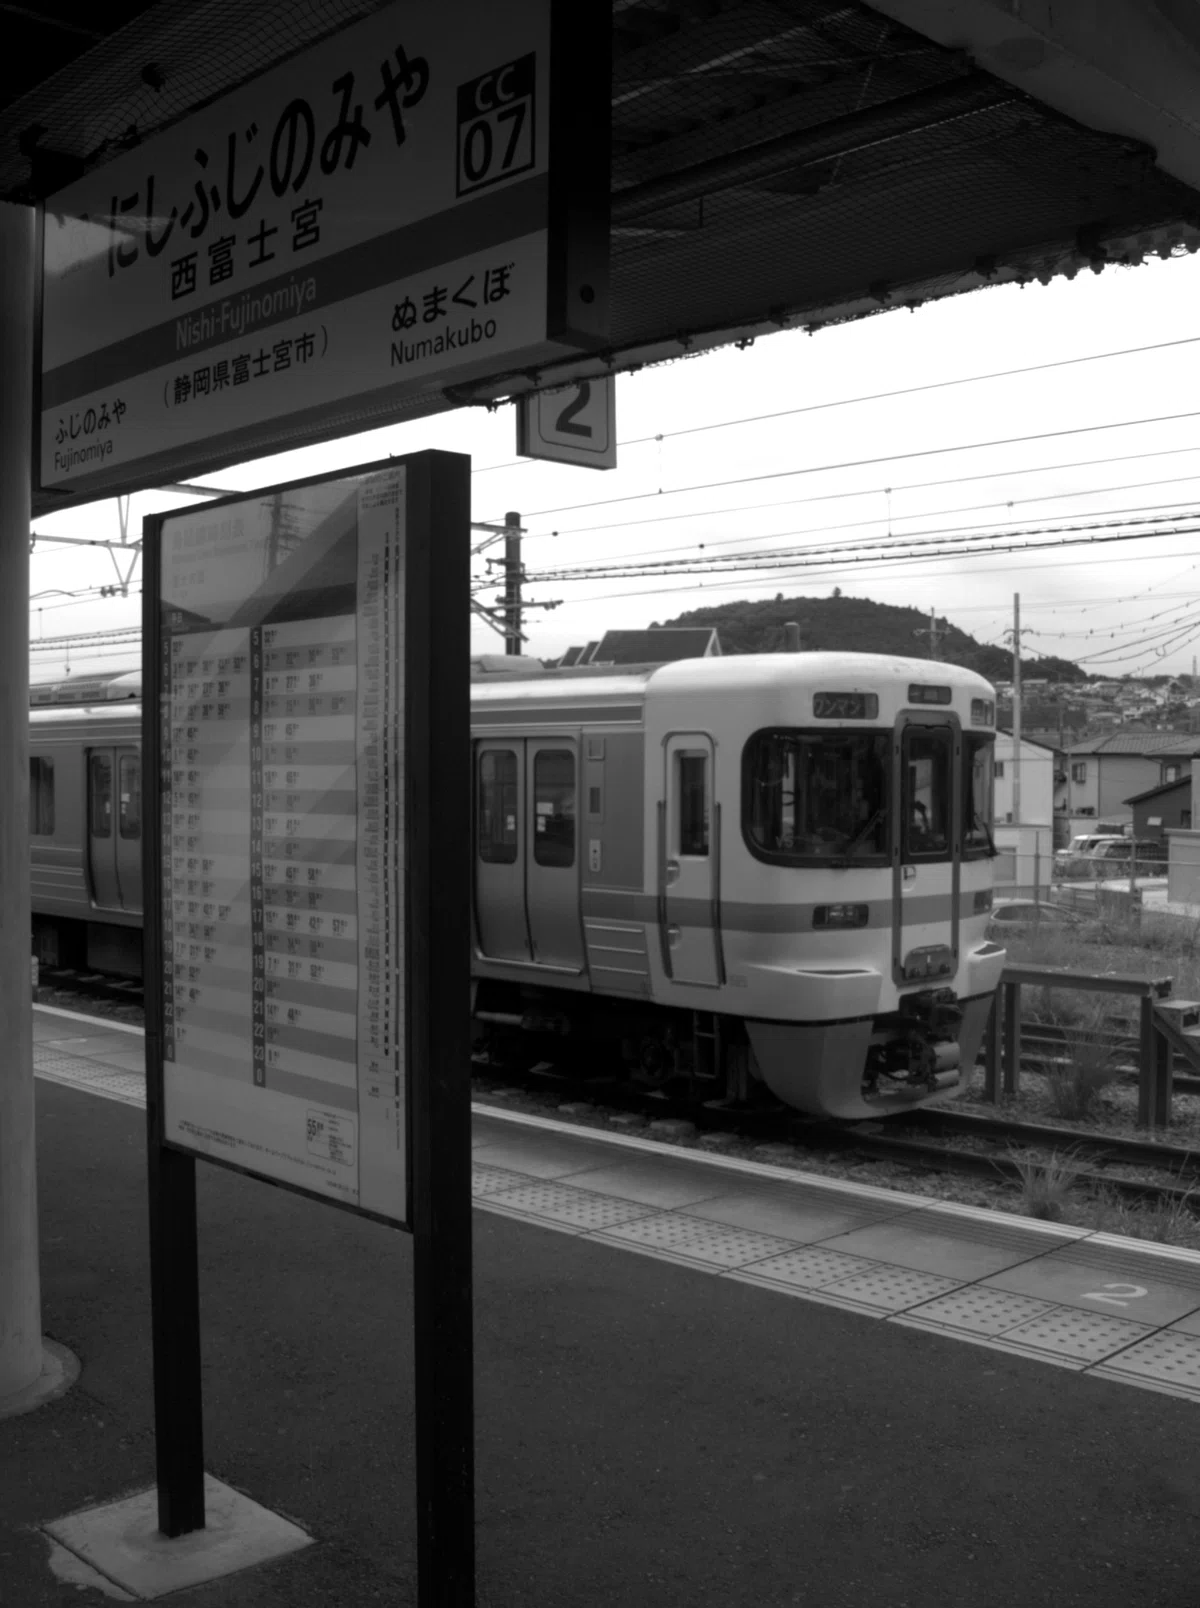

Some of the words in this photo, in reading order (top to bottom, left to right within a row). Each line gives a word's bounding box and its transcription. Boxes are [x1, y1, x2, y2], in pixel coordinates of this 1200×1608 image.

[473, 65, 515, 113] CC
[463, 110, 526, 182] 07
[107, 44, 430, 277] にしふじのみや
[171, 197, 323, 301] 西富士宮
[390, 262, 515, 332] ぬまくぼ
[175, 274, 318, 351] Nishi-Fujinomiya
[390, 316, 498, 367] Numakubo
[555, 380, 592, 438] 2
[54, 399, 128, 446] ふじのみや
[53, 437, 114, 473] Fujinomiya
[252, 631, 259, 646] 5
[252, 654, 259, 669] 6
[253, 677, 259, 693] 7
[251, 746, 262, 761] 10
[251, 793, 262, 807] 12
[251, 839, 262, 853] 14
[251, 862, 262, 876] 15
[251, 886, 262, 899] 16
[252, 908, 263, 922] 17
[253, 931, 263, 945] 18
[164, 961, 173, 974] 20
[253, 954, 264, 968] 19
[164, 982, 173, 995] 21
[253, 977, 264, 991] 20
[164, 1004, 173, 1016] 22
[254, 1000, 264, 1015] 21
[254, 1023, 264, 1038] 22
[254, 1045, 264, 1060] 23
[257, 1068, 263, 1083] 0
[1079, 1282, 1148, 1307] 2
